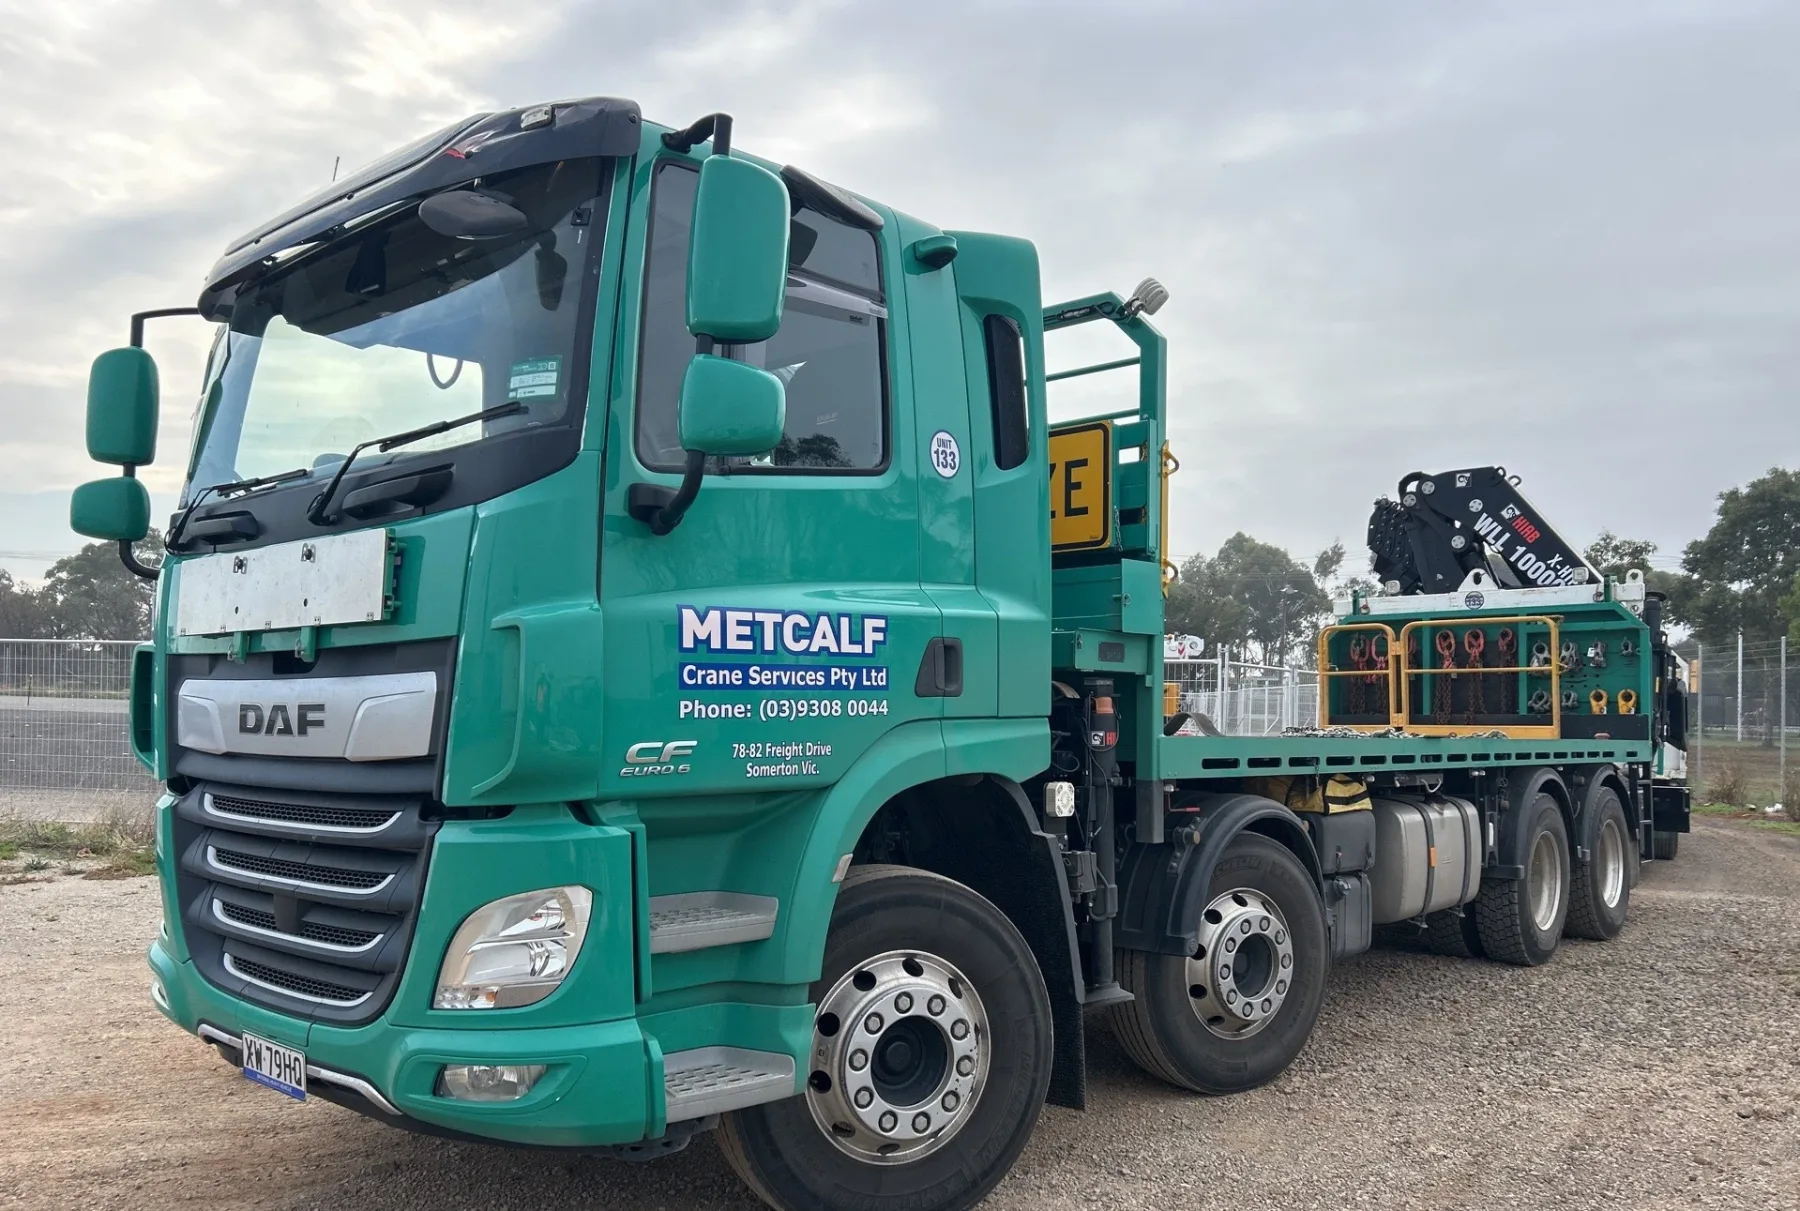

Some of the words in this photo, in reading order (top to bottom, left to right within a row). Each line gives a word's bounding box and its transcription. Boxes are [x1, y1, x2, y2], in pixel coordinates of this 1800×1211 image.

[936, 437, 953, 449] UNIT
[933, 448, 957, 470] 133
[1473, 512, 1511, 552] WLL
[1511, 515, 1541, 544] HIAB
[680, 607, 887, 655] METCALF
[681, 664, 743, 686] Crane
[748, 666, 825, 686] Services
[829, 667, 857, 690] Pty
[861, 667, 887, 686] Ltd
[238, 703, 326, 736] DAF
[678, 700, 752, 719] Phone:
[758, 699, 842, 722] (03)9308
[846, 699, 889, 717] 0044
[625, 740, 698, 764] CF
[731, 744, 763, 759] 78-82
[765, 742, 804, 761] Freight
[805, 741, 832, 757] Drive
[620, 765, 675, 777] EURO
[677, 764, 691, 774] 6
[745, 760, 799, 778] Somerton
[801, 759, 820, 776] Vic.
